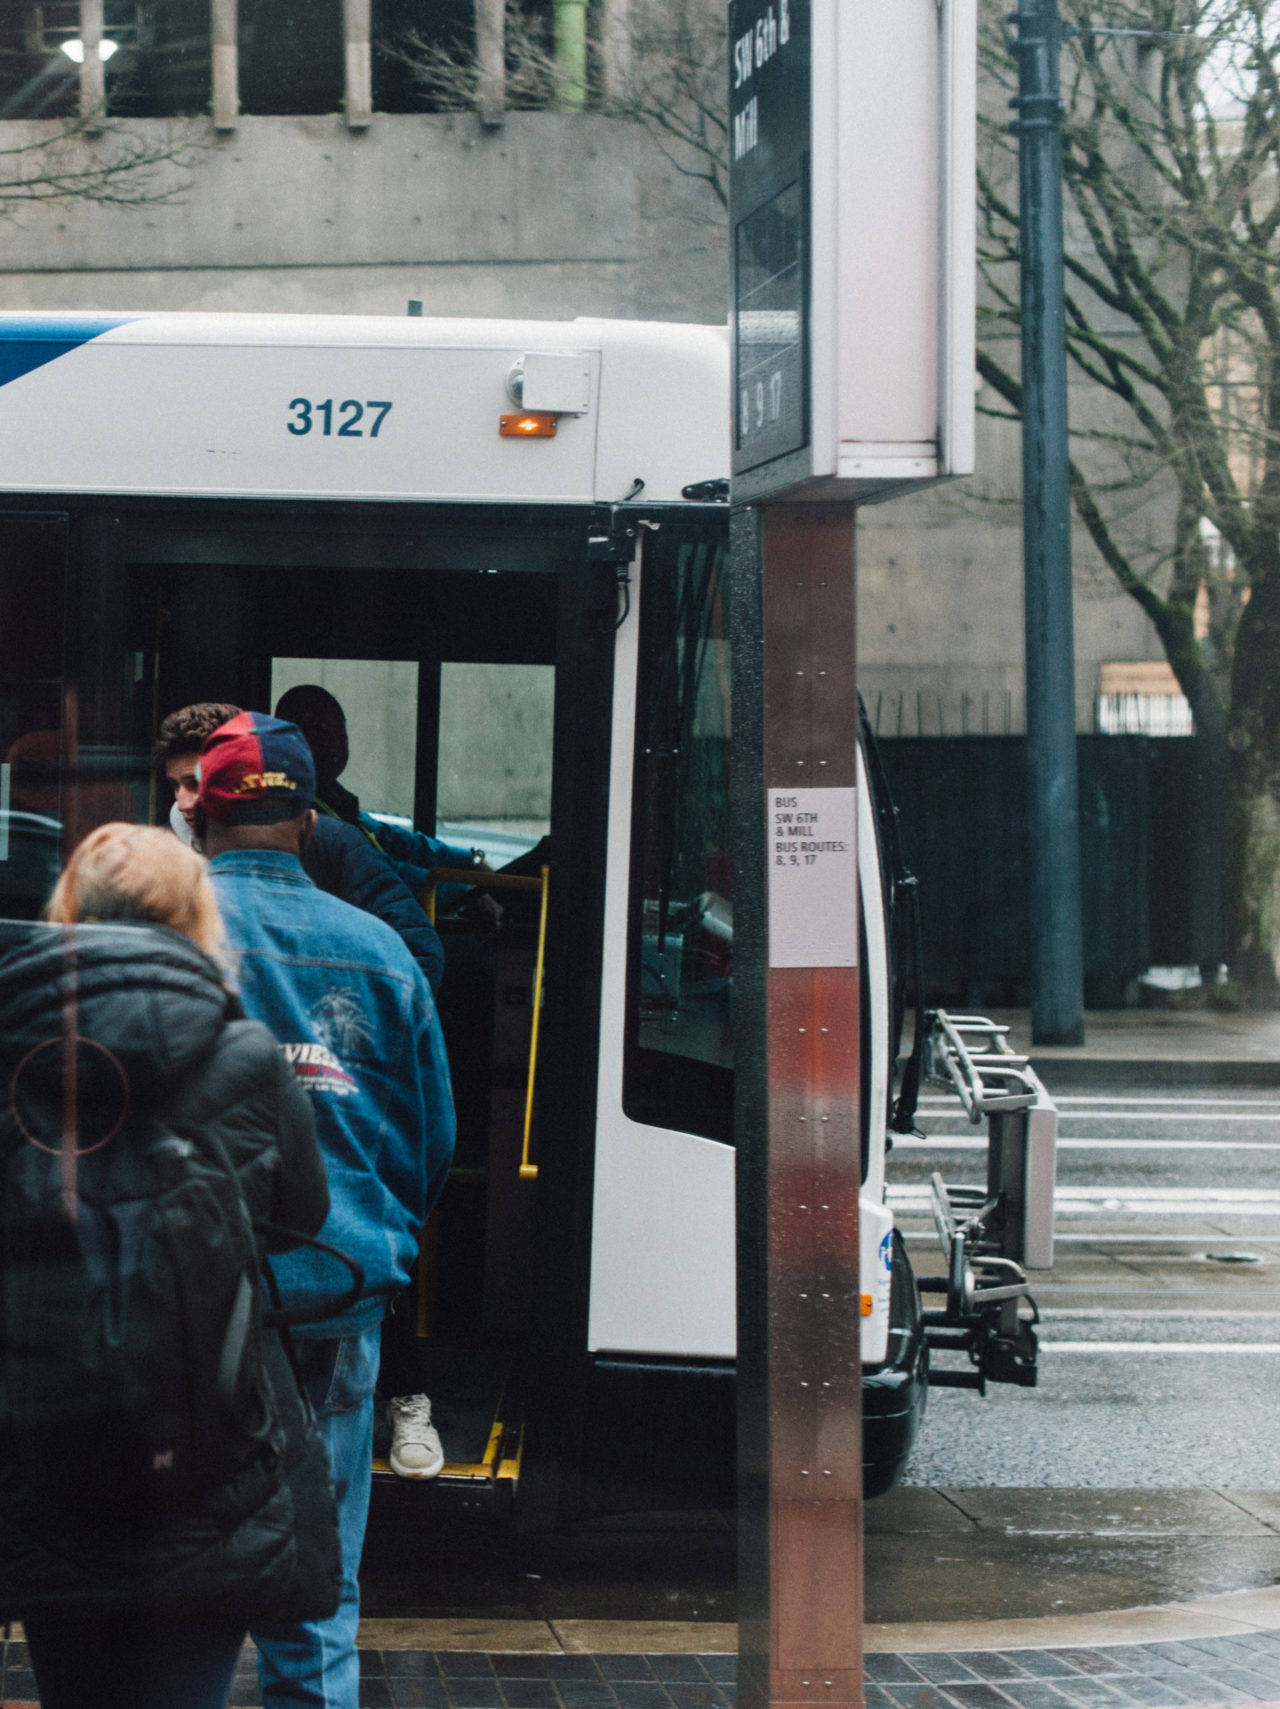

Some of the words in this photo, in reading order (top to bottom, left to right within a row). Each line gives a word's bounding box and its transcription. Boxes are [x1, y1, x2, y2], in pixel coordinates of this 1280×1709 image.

[734, 29, 753, 88] SW
[755, 6, 777, 68] 6th
[734, 96, 758, 160] Mill
[742, 388, 749, 435] 8
[756, 381, 764, 428] 9
[770, 370, 782, 420] 17
[287, 397, 393, 437] 3127
[775, 797, 798, 808] BUS
[775, 813, 793, 824] SW
[796, 813, 818, 824] 6TH
[776, 826, 784, 836] &
[788, 826, 814, 836] MILL
[775, 842, 798, 852] BUS
[801, 841, 849, 852] ROUTES:
[776, 855, 786, 866] 8,
[790, 855, 800, 866] 9,
[805, 855, 816, 865] 17
